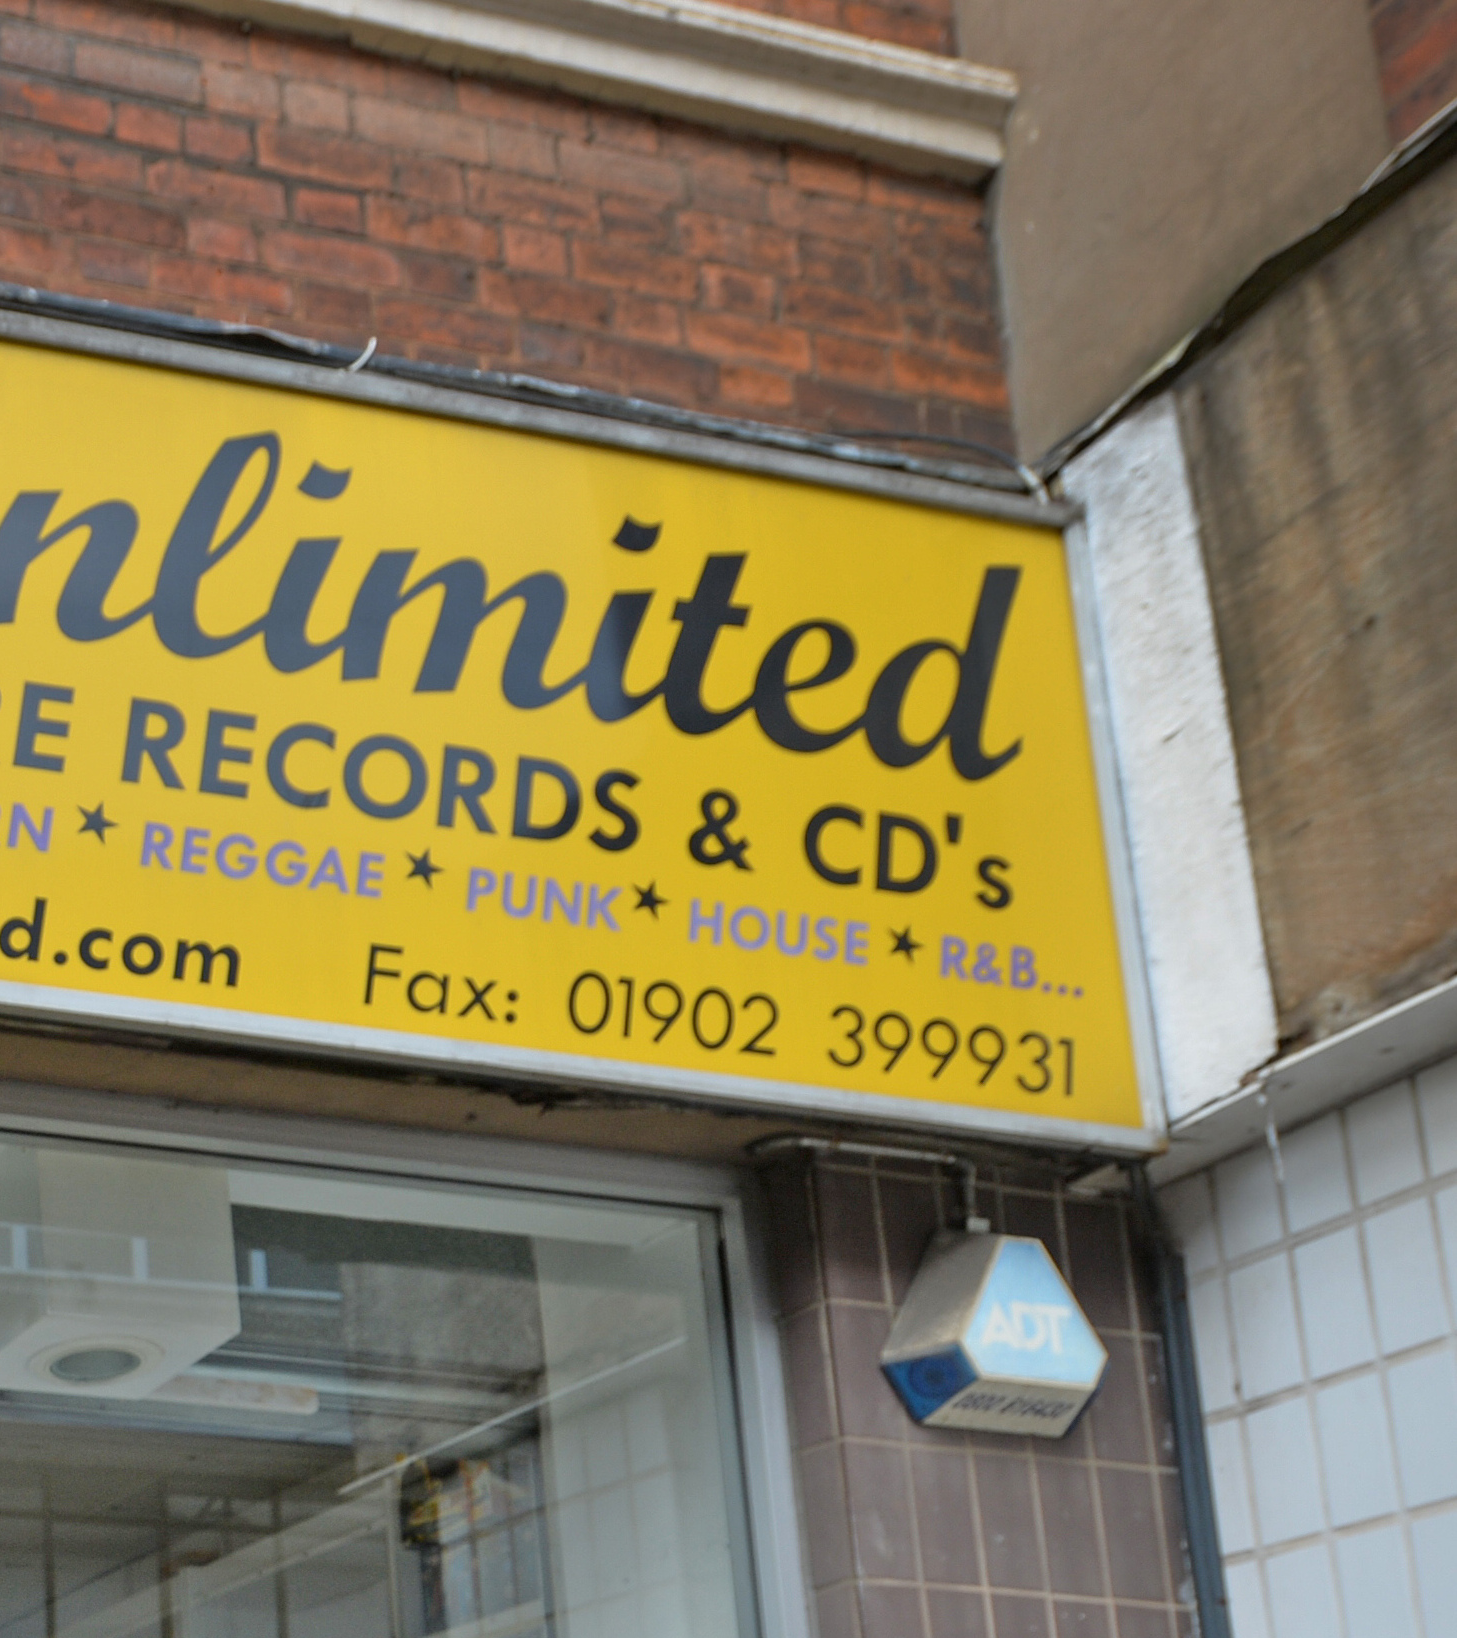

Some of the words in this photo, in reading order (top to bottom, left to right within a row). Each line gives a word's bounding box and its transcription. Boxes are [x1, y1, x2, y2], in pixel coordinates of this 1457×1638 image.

[120, 696, 640, 853] RECORDS
[687, 788, 754, 873] &
[803, 802, 1013, 911] CD's
[140, 821, 386, 900] REGGAE
[465, 867, 623, 933] PUNK
[687, 897, 871, 967] HOUSE
[939, 935, 1086, 1000] R&B...
[364, 943, 519, 1025] Fax:
[567, 971, 781, 1058] 01902
[826, 1004, 1076, 1098] 399931
[981, 1300, 1071, 1355] ADT
